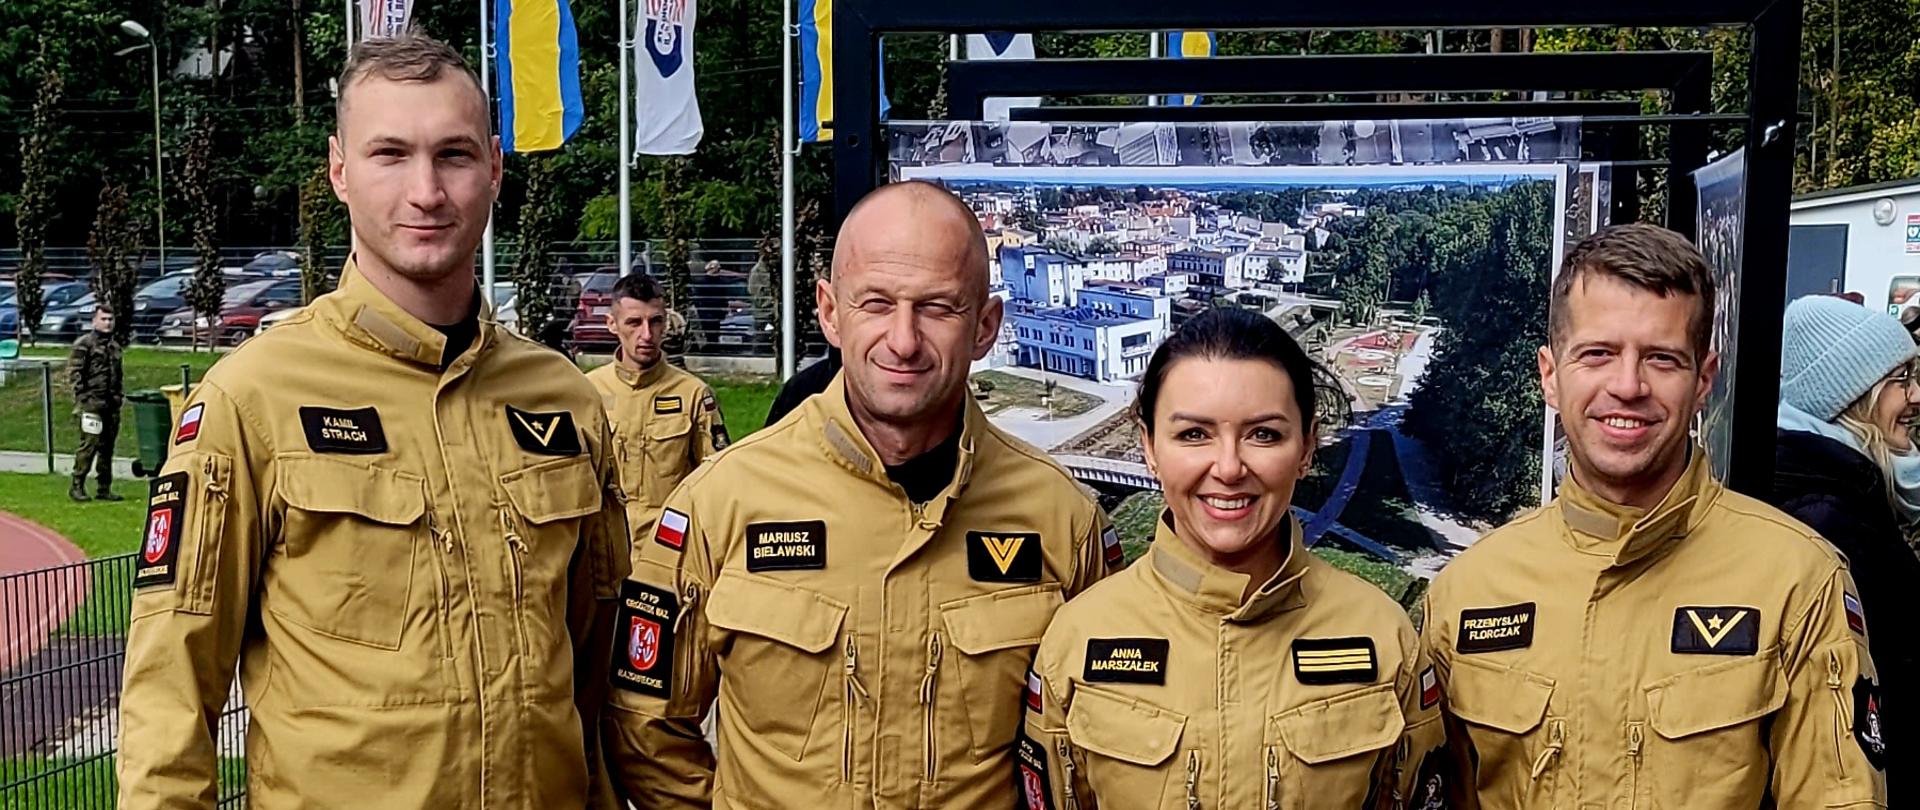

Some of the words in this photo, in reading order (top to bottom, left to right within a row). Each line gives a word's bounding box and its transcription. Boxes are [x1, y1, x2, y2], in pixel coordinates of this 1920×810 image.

[323, 416, 359, 430] KAMIL
[321, 428, 368, 442] STRACH
[759, 531, 810, 545] MARIUSZ
[753, 544, 816, 559] BIELAWSKI
[1469, 625, 1521, 641] FLORCZAK
[1110, 648, 1142, 660] ANNA
[1091, 659, 1160, 673] MARSZAŁEK
